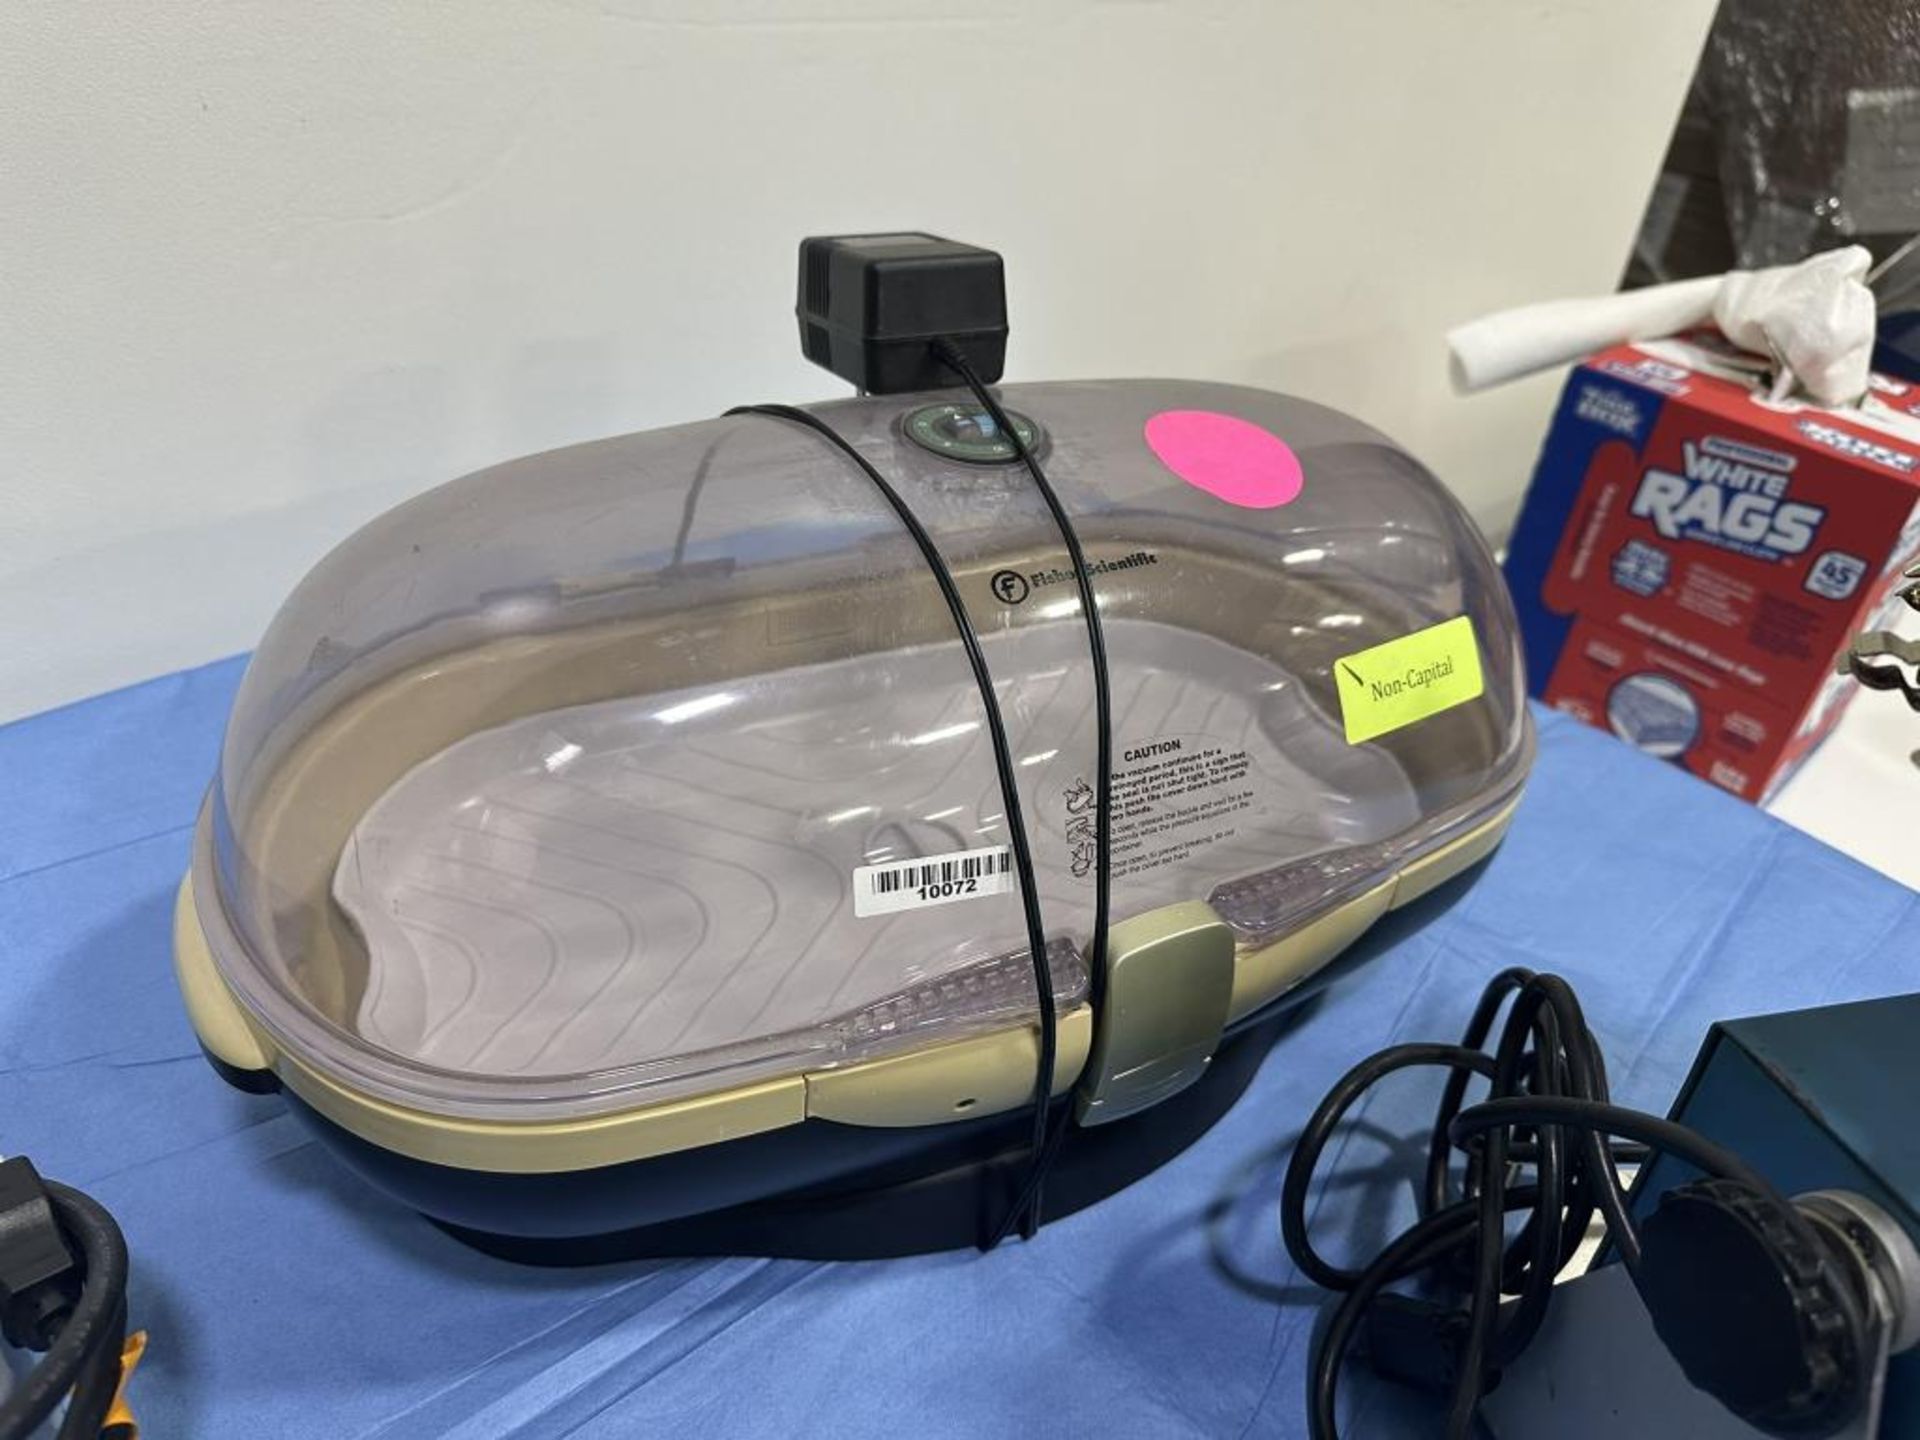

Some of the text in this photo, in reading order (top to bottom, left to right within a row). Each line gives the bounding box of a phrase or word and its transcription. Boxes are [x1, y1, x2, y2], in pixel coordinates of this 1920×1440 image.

[1683, 441, 1788, 497] WHITE
[1631, 469, 1824, 553] RAGS
[1029, 570, 1077, 588] Fishe
[1086, 552, 1158, 576] Scientific
[1822, 561, 1852, 585] 45
[1371, 655, 1453, 702] Non-Capital
[1124, 739, 1181, 762] CAUTION
[1127, 764, 1160, 776] vacuum
[1162, 753, 1201, 768] continues
[1203, 750, 1214, 758] for
[1179, 764, 1194, 774] this
[1213, 757, 1228, 766] sign
[1230, 751, 1246, 760] that
[1122, 788, 1140, 798] seal
[1151, 782, 1165, 791] not
[1220, 761, 1248, 773] remedy
[1125, 797, 1145, 808] push
[1147, 794, 1161, 802] the
[1162, 787, 1185, 798] cover
[1186, 781, 1208, 792] down
[917, 879, 976, 900] 10072
